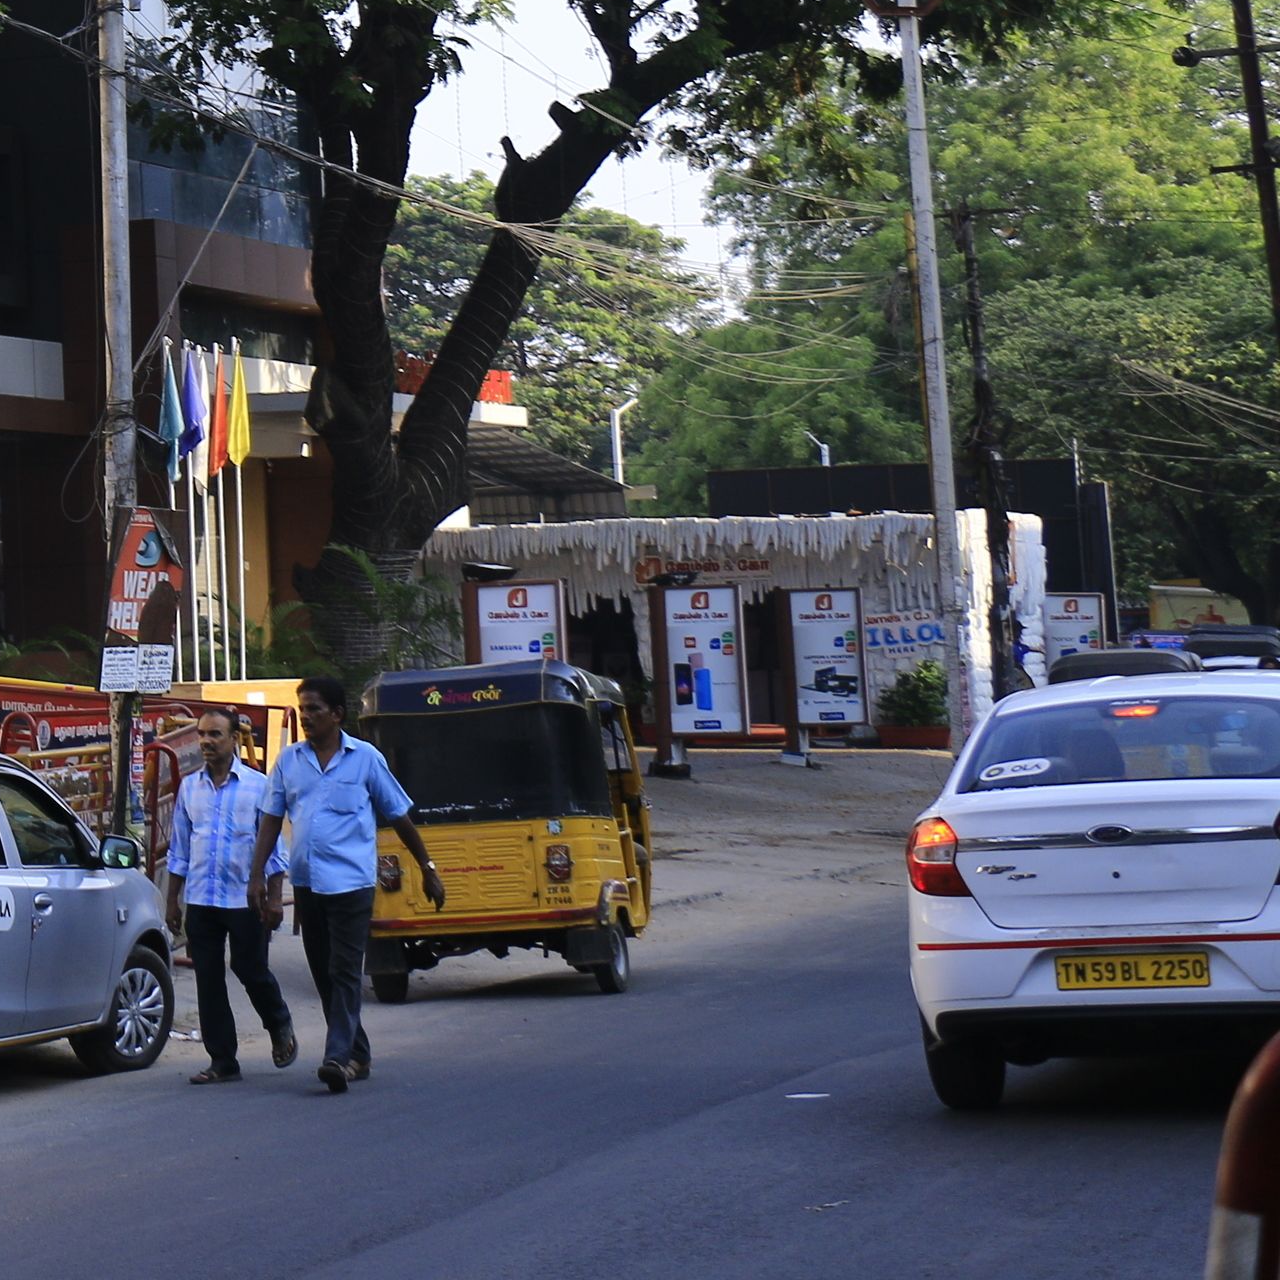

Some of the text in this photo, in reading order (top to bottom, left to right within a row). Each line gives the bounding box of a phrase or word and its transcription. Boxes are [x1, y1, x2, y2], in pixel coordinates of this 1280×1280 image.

[123, 571, 169, 600] WEA
[110, 602, 141, 630] HEL
[864, 615, 901, 626] James
[889, 646, 916, 654] HERE
[1010, 762, 1041, 772] OLA
[1060, 959, 1205, 984] TN 59 BL 2250
